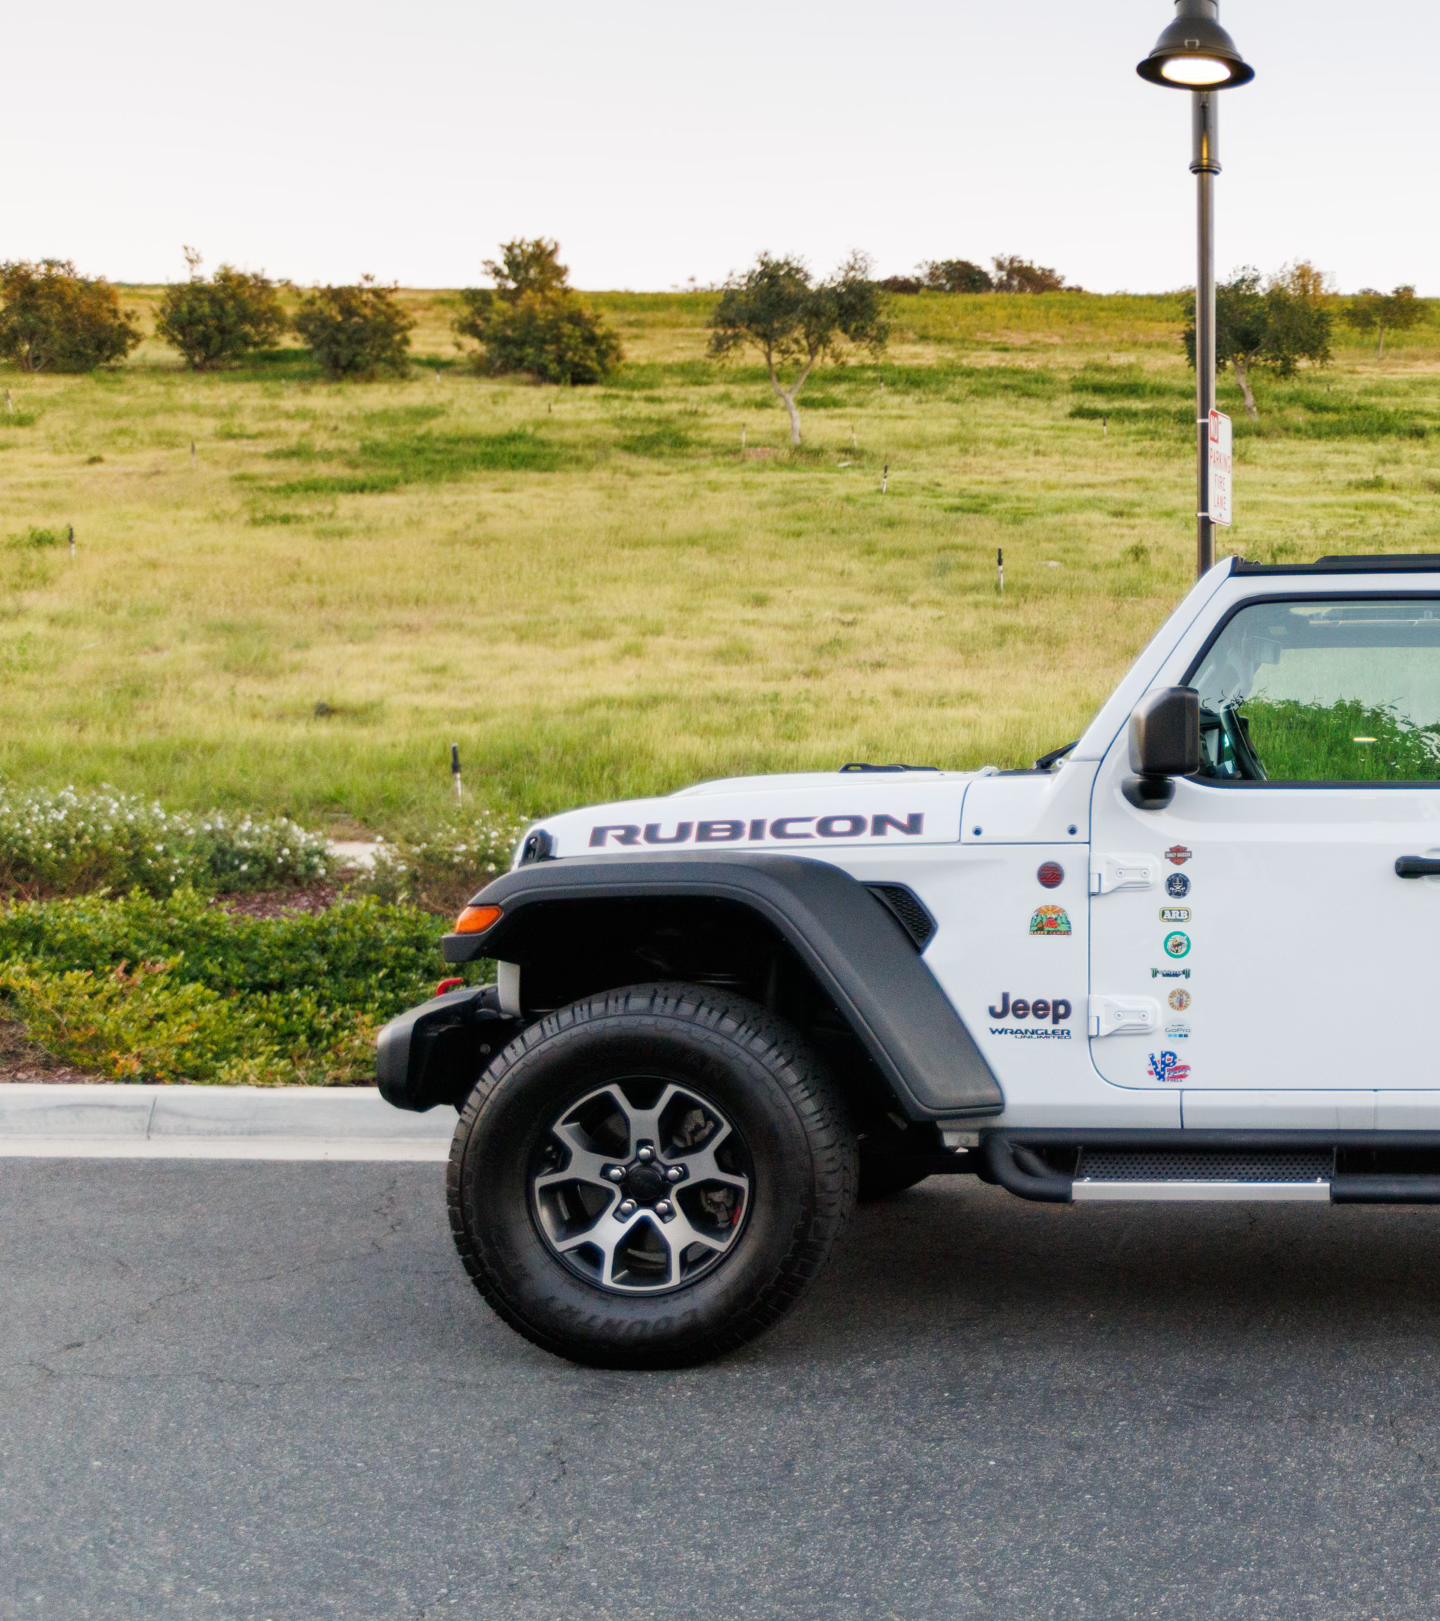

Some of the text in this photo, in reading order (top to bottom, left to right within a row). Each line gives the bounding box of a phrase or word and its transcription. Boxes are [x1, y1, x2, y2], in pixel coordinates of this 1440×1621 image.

[588, 812, 925, 848] RUBICON
[1163, 910, 1188, 919] ARB
[988, 992, 1072, 1024] Jeep
[989, 1027, 1071, 1035] WRANGLER
